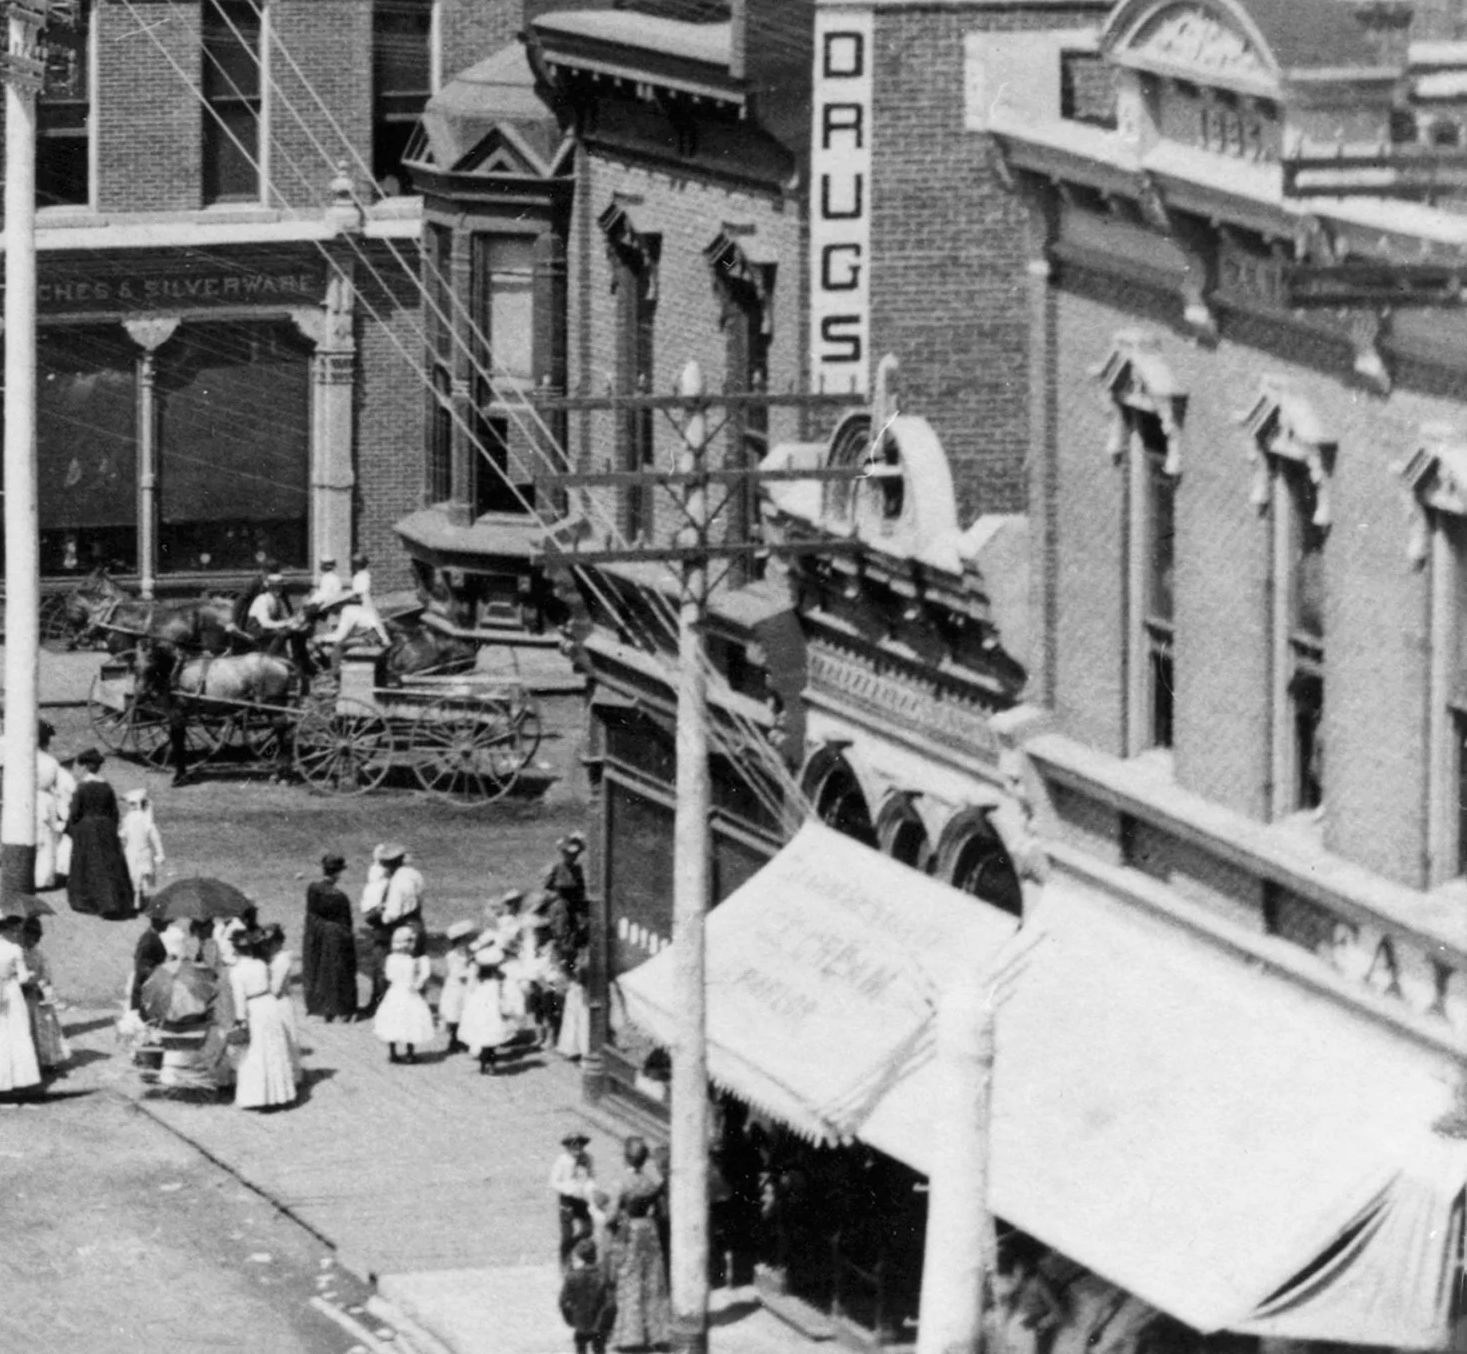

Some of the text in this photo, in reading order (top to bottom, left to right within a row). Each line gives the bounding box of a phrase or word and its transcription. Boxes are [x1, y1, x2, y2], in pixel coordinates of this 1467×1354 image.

[821, 31, 865, 363] DRUGS
[119, 281, 131, 297] &
[144, 275, 315, 297] SILVERWARE
